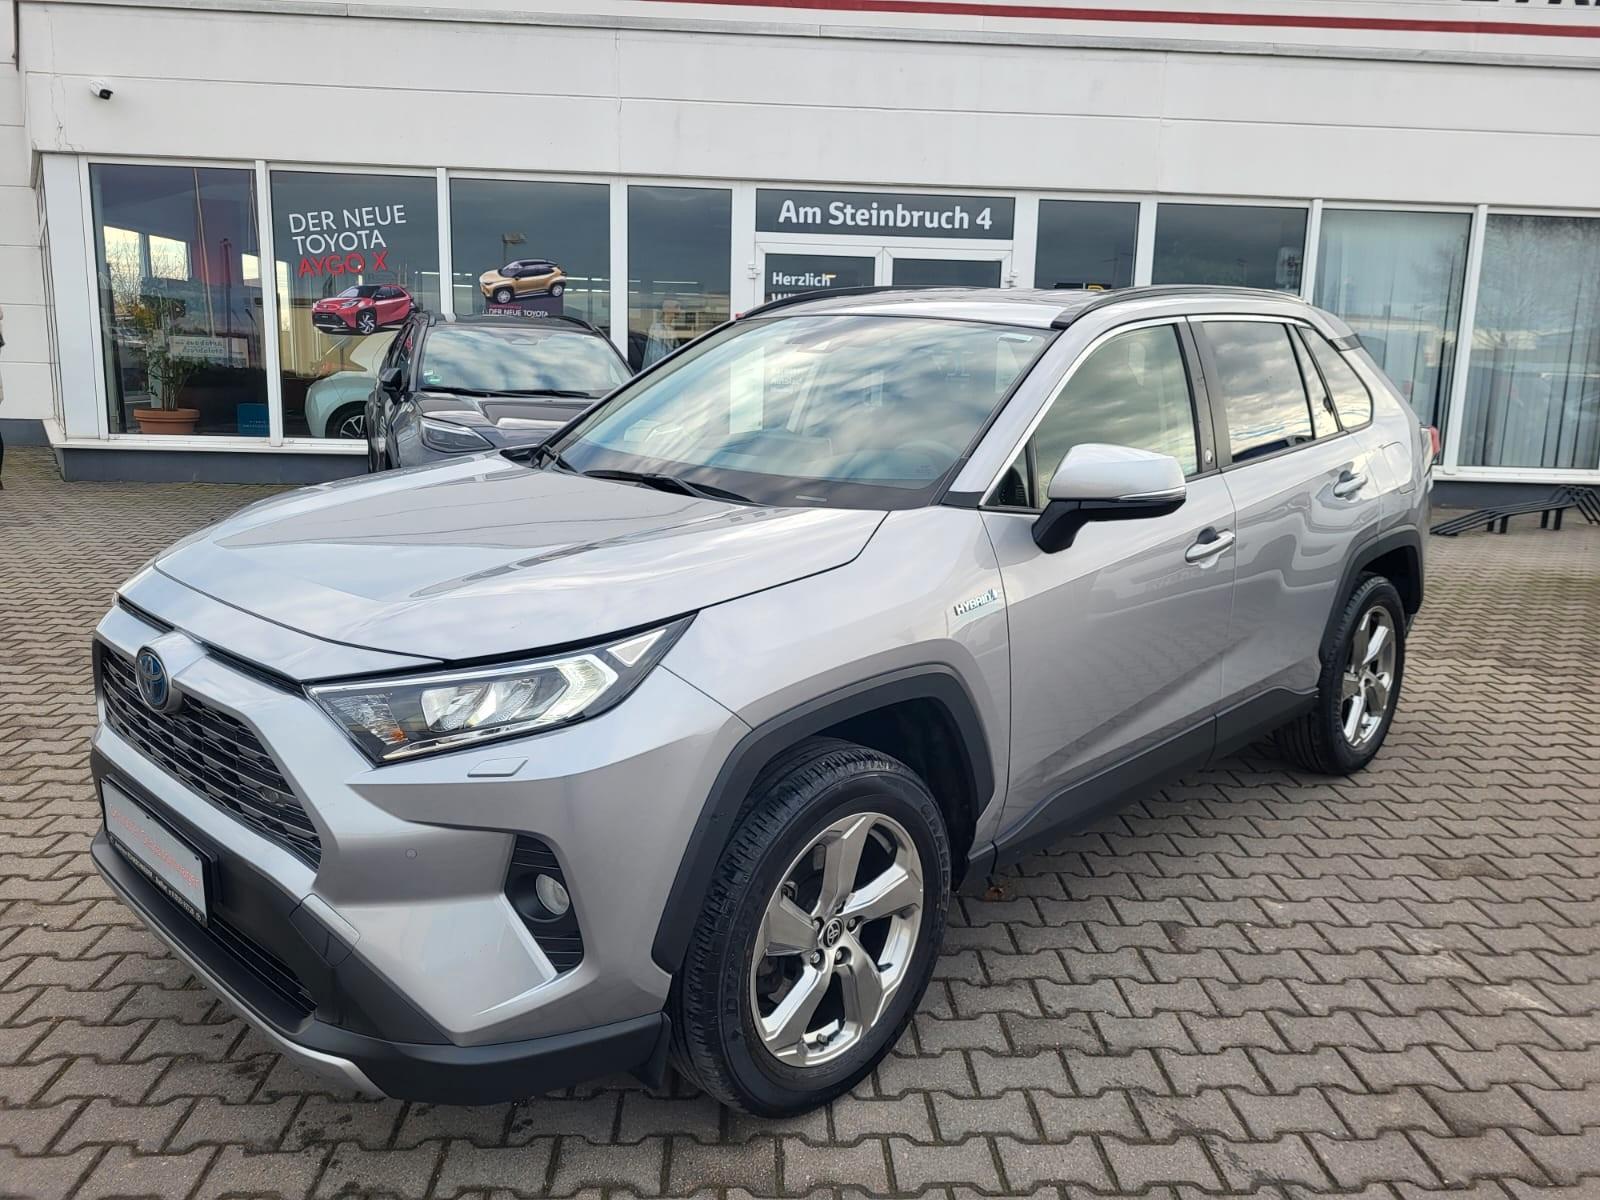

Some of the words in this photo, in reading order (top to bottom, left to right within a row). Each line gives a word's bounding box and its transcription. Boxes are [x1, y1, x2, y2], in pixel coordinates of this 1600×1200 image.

[289, 211, 337, 233] DER
[342, 205, 407, 229] NEUE
[778, 200, 822, 224] Am
[828, 201, 969, 229] Steinbruch
[975, 207, 993, 230] 4
[292, 229, 387, 255] TOYOTA
[298, 252, 365, 278] AYGO
[371, 250, 389, 272] X
[772, 271, 831, 287] Herzlich
[488, 308, 502, 316] DER
[503, 308, 521, 317] NEUE
[523, 310, 550, 319] TOYOTA
[953, 590, 993, 616] HYBRID
